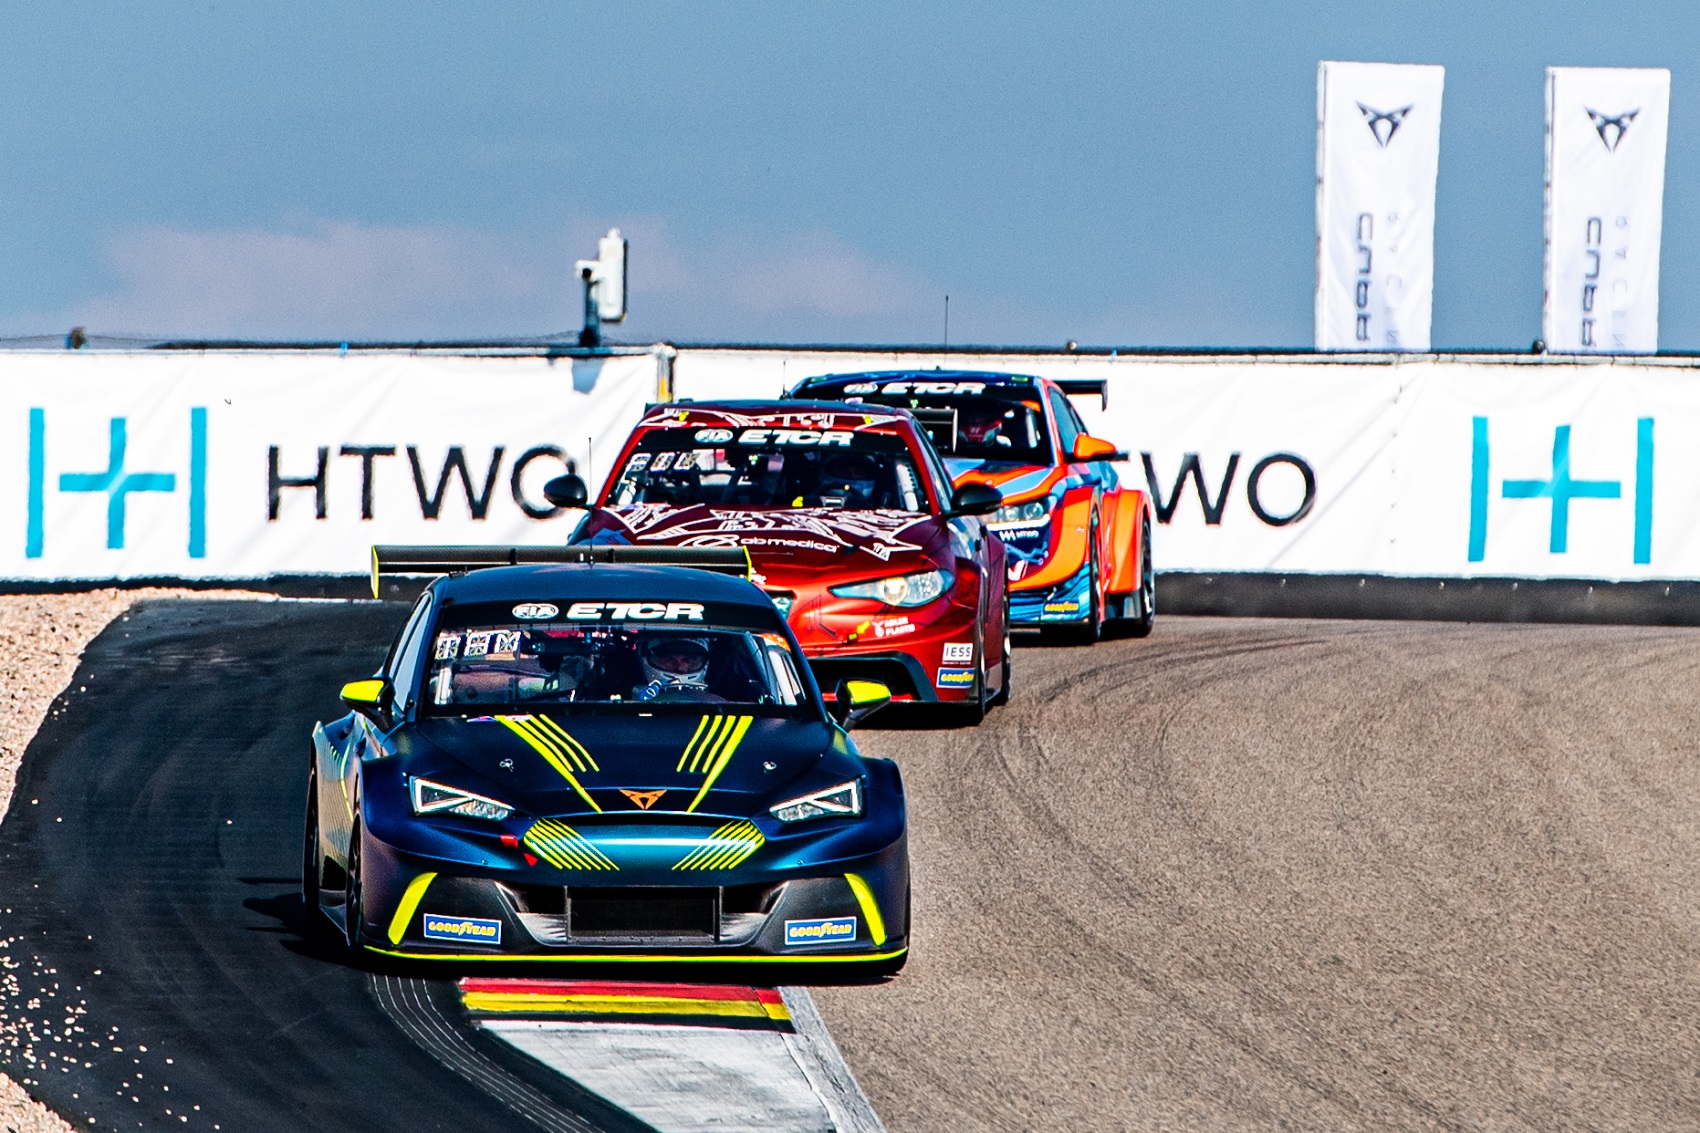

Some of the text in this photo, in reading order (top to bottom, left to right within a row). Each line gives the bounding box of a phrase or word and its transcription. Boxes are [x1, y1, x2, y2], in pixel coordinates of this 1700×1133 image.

[881, 382, 986, 395] ETCR
[738, 429, 854, 447] ETCR
[267, 445, 577, 521] HTWO
[1116, 451, 1317, 527] WO
[515, 602, 705, 621] FIA ETCR
[428, 921, 496, 937] GOODYEAR
[789, 922, 852, 938] GOODYEAR
